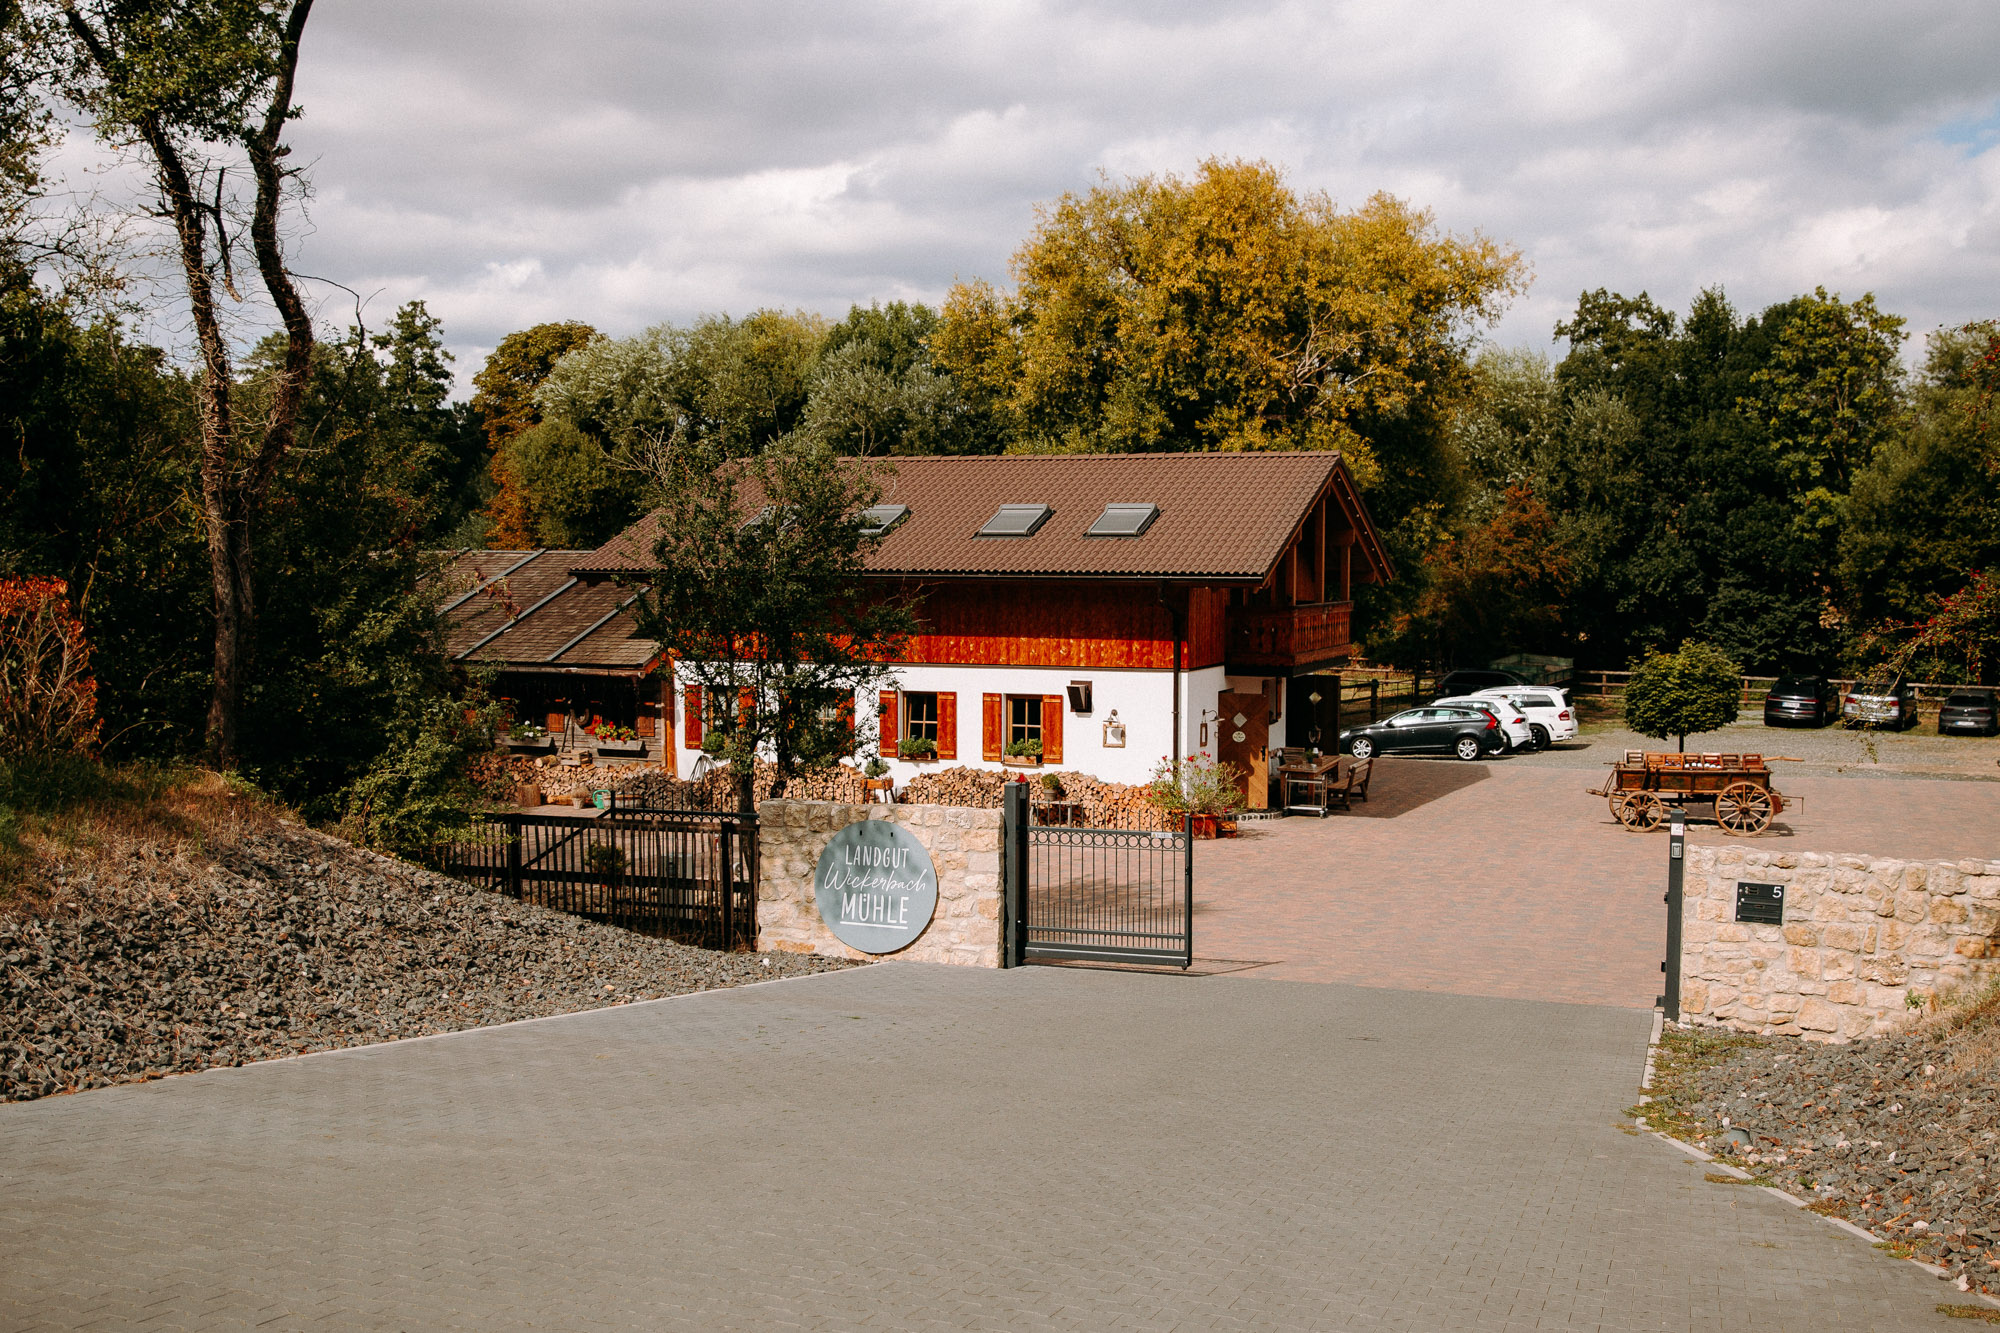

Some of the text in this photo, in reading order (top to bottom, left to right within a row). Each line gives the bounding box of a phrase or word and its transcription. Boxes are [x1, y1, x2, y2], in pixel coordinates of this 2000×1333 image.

[845, 844, 910, 869] LANDGUT
[823, 861, 928, 892] Wickerbach
[1772, 886, 1782, 898] 5
[841, 892, 909, 924] MÜHLE
